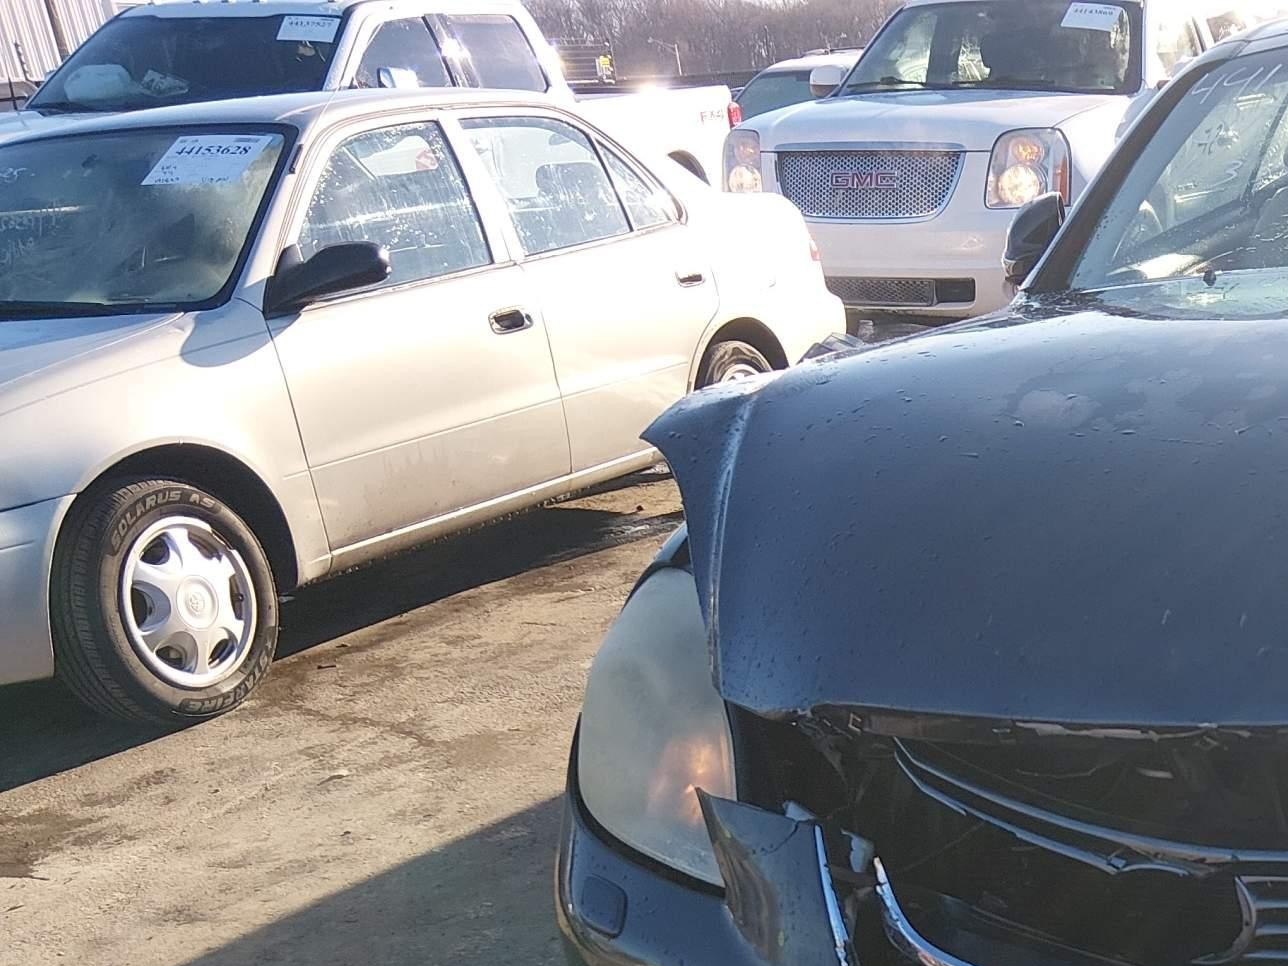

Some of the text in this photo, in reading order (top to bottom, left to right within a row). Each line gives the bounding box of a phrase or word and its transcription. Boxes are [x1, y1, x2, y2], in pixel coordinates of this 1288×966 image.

[175, 145, 252, 156] 44153628
[830, 171, 898, 189] GMC
[111, 490, 216, 547] SOLARUS AS
